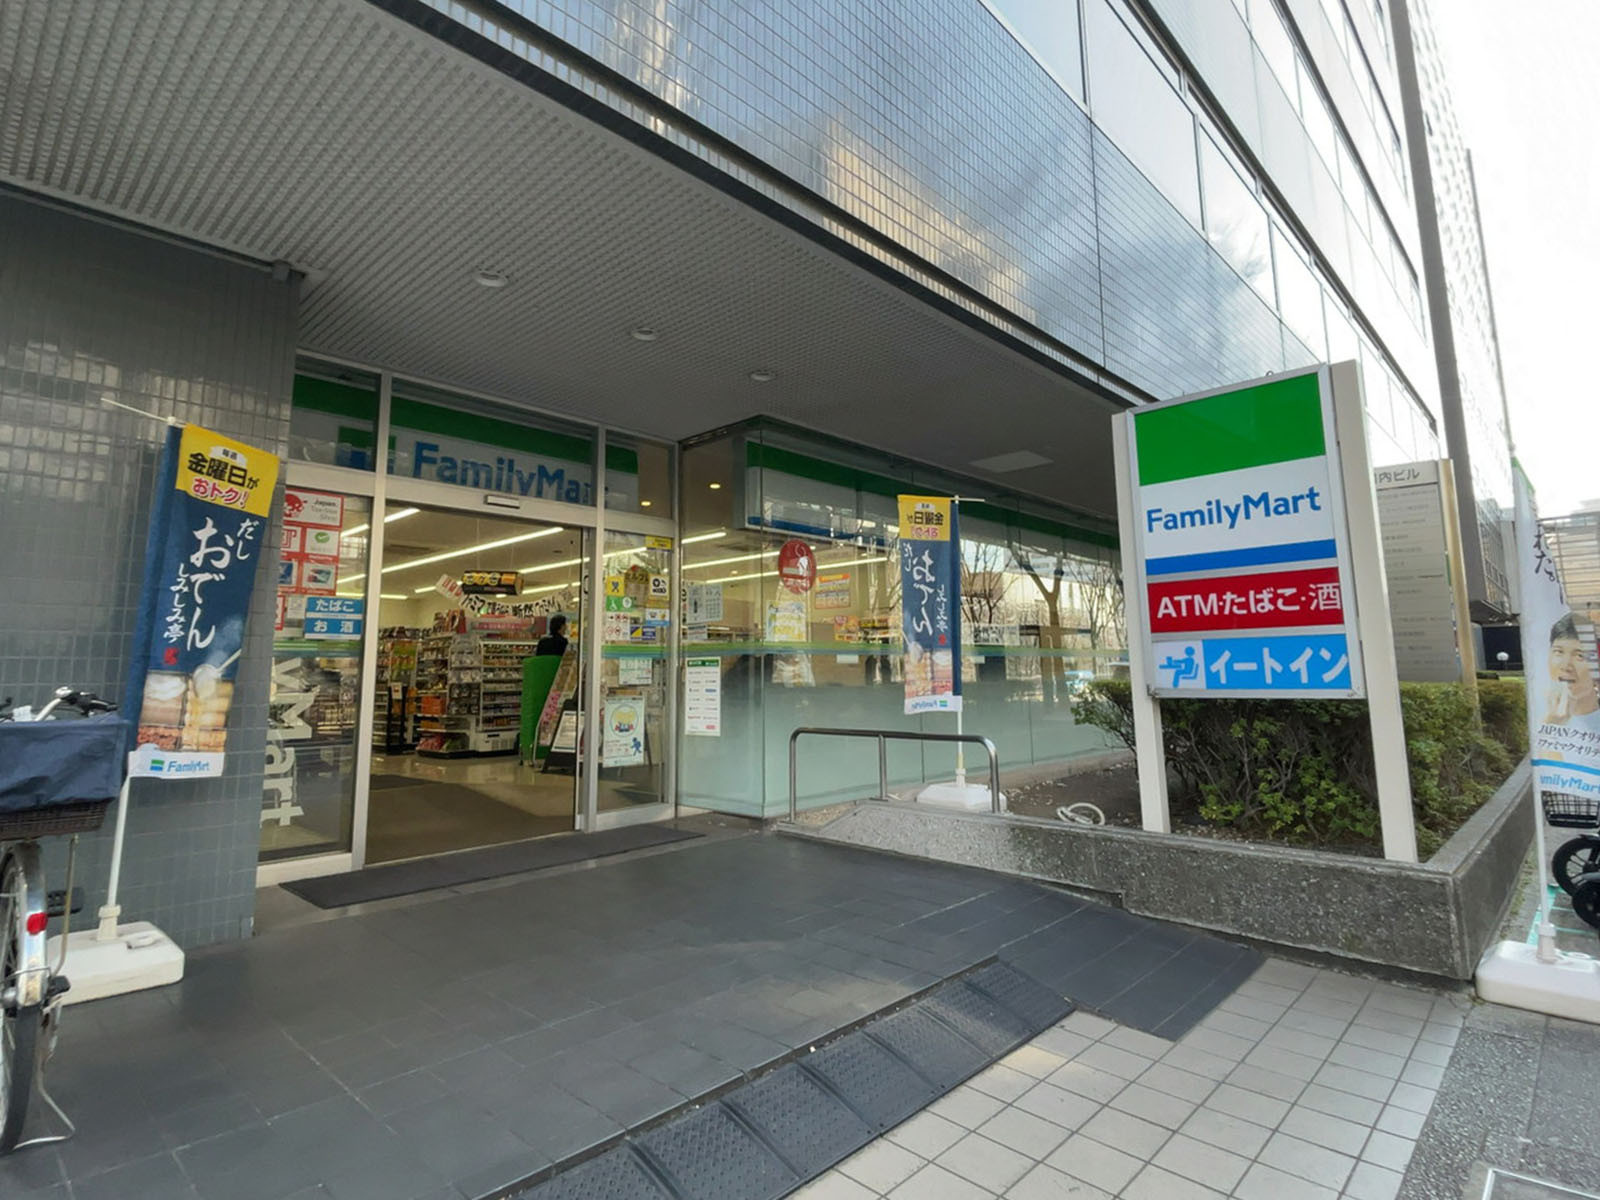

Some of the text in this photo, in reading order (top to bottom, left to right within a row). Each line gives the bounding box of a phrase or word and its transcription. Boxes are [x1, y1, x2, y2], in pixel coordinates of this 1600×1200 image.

[187, 452, 260, 490] 金曜日が
[1374, 468, 1421, 484] 内ビル
[193, 478, 249, 508] おトク!
[1146, 486, 1321, 533] FamilyMart
[236, 518, 260, 560] だし
[186, 516, 234, 651] おでん
[163, 563, 189, 643] しみしみ亭
[316, 599, 355, 612] たばこ
[1209, 647, 1348, 684] イートイン
